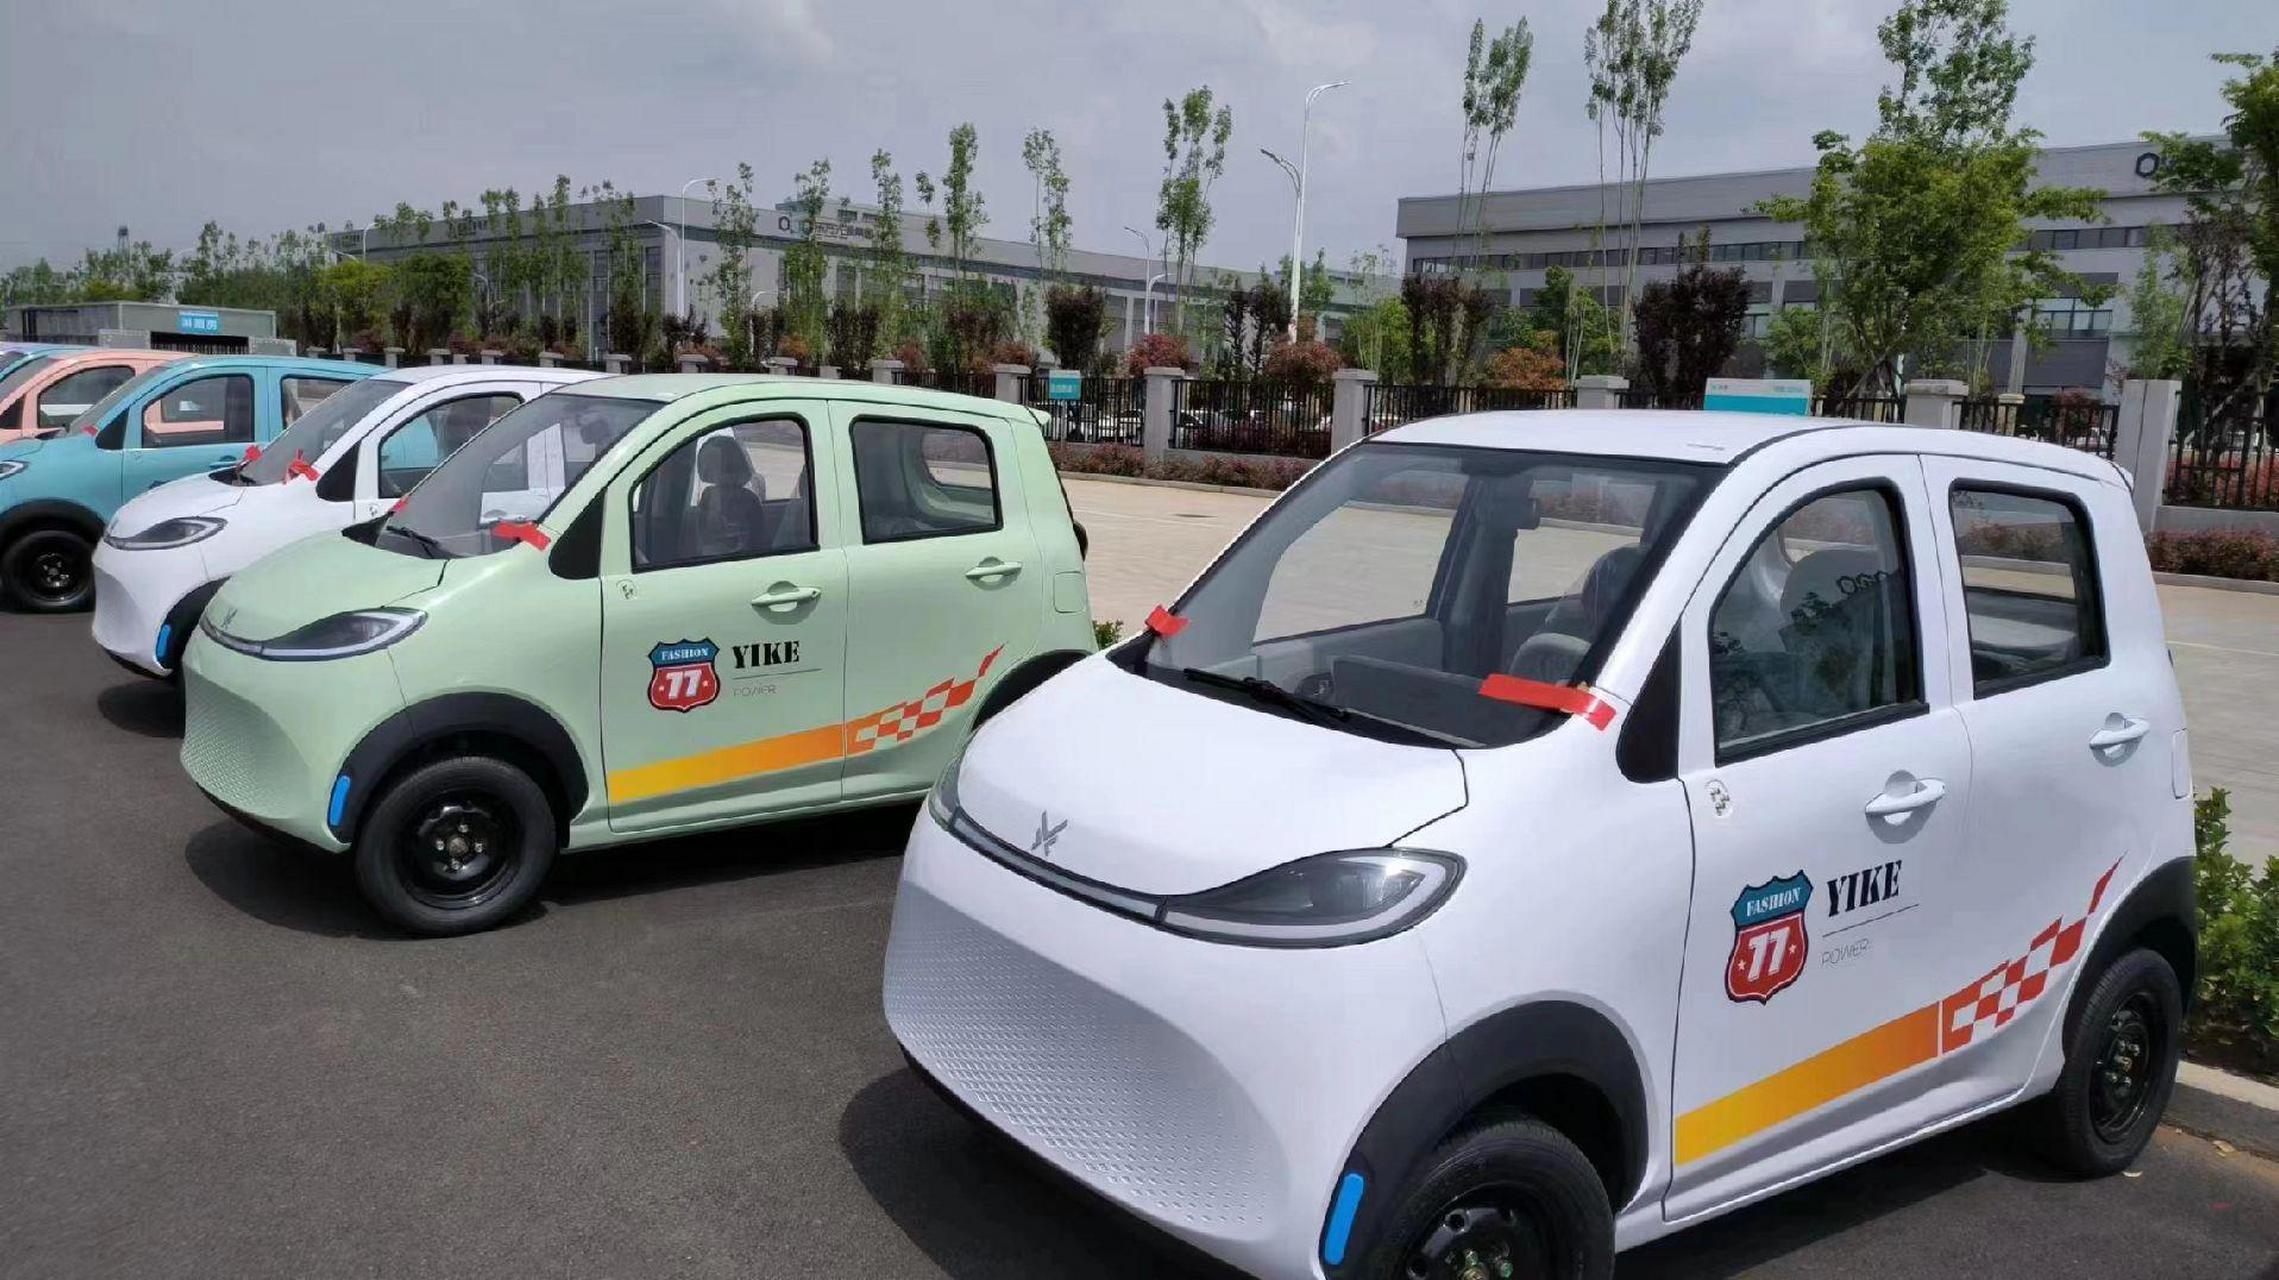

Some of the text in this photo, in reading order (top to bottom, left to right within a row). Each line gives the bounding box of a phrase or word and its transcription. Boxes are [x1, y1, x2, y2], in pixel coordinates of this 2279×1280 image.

[661, 647, 709, 661] FASHION
[732, 640, 800, 669] YIKE
[666, 669, 702, 699] 77
[733, 684, 777, 697] POWER
[1746, 887, 1801, 917] FASHION
[1827, 860, 1902, 917] YIKE
[1748, 926, 1791, 982] 77
[1821, 938, 1869, 966] POWER
